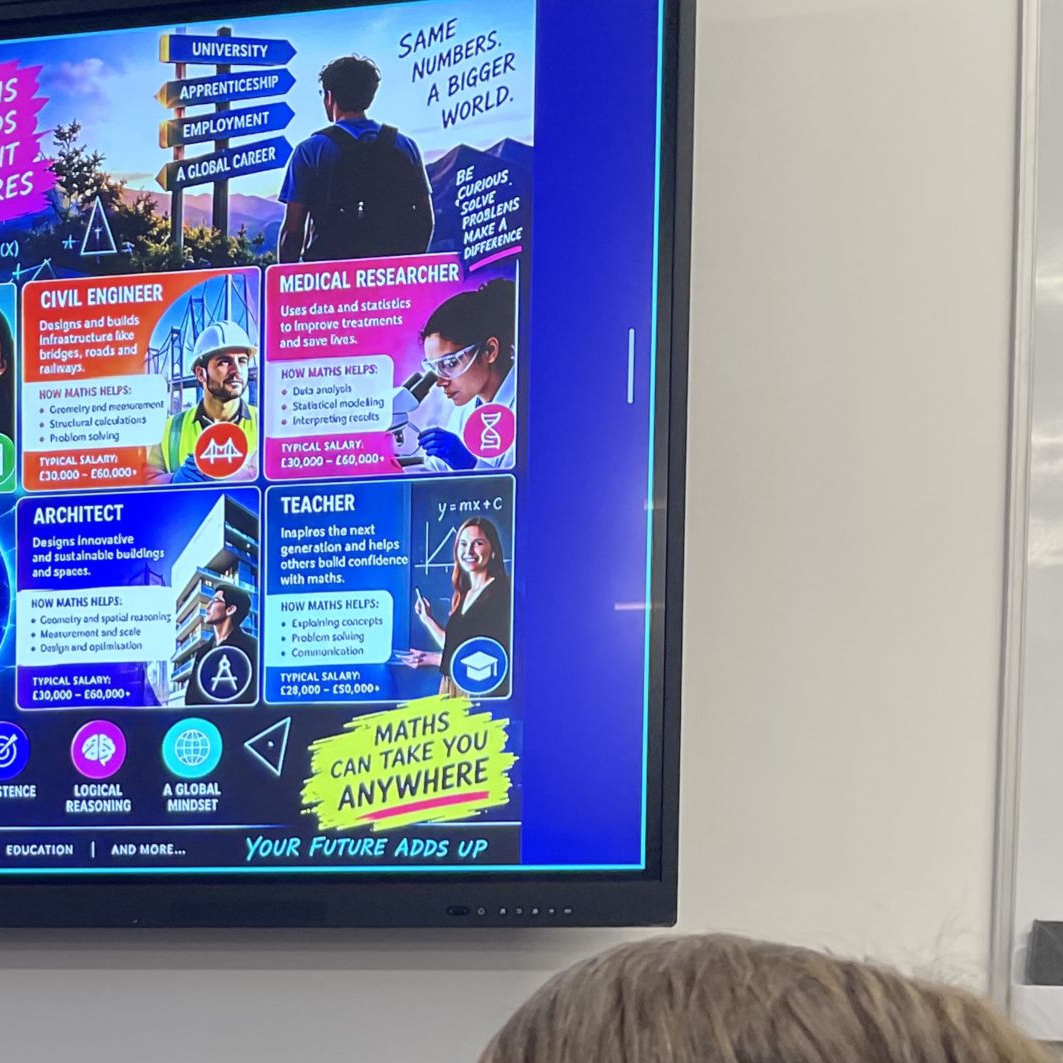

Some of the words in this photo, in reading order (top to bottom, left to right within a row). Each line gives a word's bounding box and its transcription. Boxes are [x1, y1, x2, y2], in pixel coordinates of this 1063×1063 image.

[192, 42, 268, 58] UNIVERSITY
[399, 18, 457, 58] SAME
[412, 30, 502, 83] NUMBERS.
[180, 75, 279, 100] APPRENTICESHIP
[427, 83, 439, 106] A
[448, 52, 516, 97] BIGGER
[442, 86, 513, 129] WORLD.
[183, 112, 269, 138] EMPLOYMENT
[176, 167, 185, 182] A
[188, 157, 231, 178] GLOBAL
[233, 146, 276, 168] CAREER
[456, 165, 475, 186] BE
[461, 190, 497, 215] SOLVE
[463, 222, 496, 244] MAKE
[499, 217, 507, 232] A
[464, 227, 523, 260] DIFFERENCE
[279, 270, 351, 293] MEDICAL
[356, 263, 459, 288] RESEARCHER
[41, 289, 83, 308] CIVIL
[87, 284, 163, 306] ENGINEER
[281, 305, 307, 316] Uses
[309, 303, 335, 314] data
[337, 300, 359, 312] and
[33, 504, 124, 524] ARCHITECT
[281, 494, 355, 514] TEACHER
[281, 574, 305, 586] with
[281, 600, 305, 612] HOW
[307, 600, 343, 611] MATHS
[375, 712, 450, 746] MATHS
[330, 754, 371, 779] CAN
[379, 740, 433, 770] TAKE
[443, 730, 488, 758] YOU
[74, 784, 123, 797] LOGICAL
[163, 783, 173, 796] A
[175, 782, 221, 796] GLOBAL
[337, 757, 489, 812] ANYWHERE
[65, 799, 131, 812] REASONING
[167, 798, 219, 812] MINDSET
[6, 844, 73, 856] EDUCATION
[111, 844, 136, 856] AND
[140, 844, 186, 856] MORE...
[246, 836, 301, 861] YOUR
[309, 836, 388, 857] FUTURE
[395, 838, 449, 858] ADDS
[459, 840, 488, 858] UP
